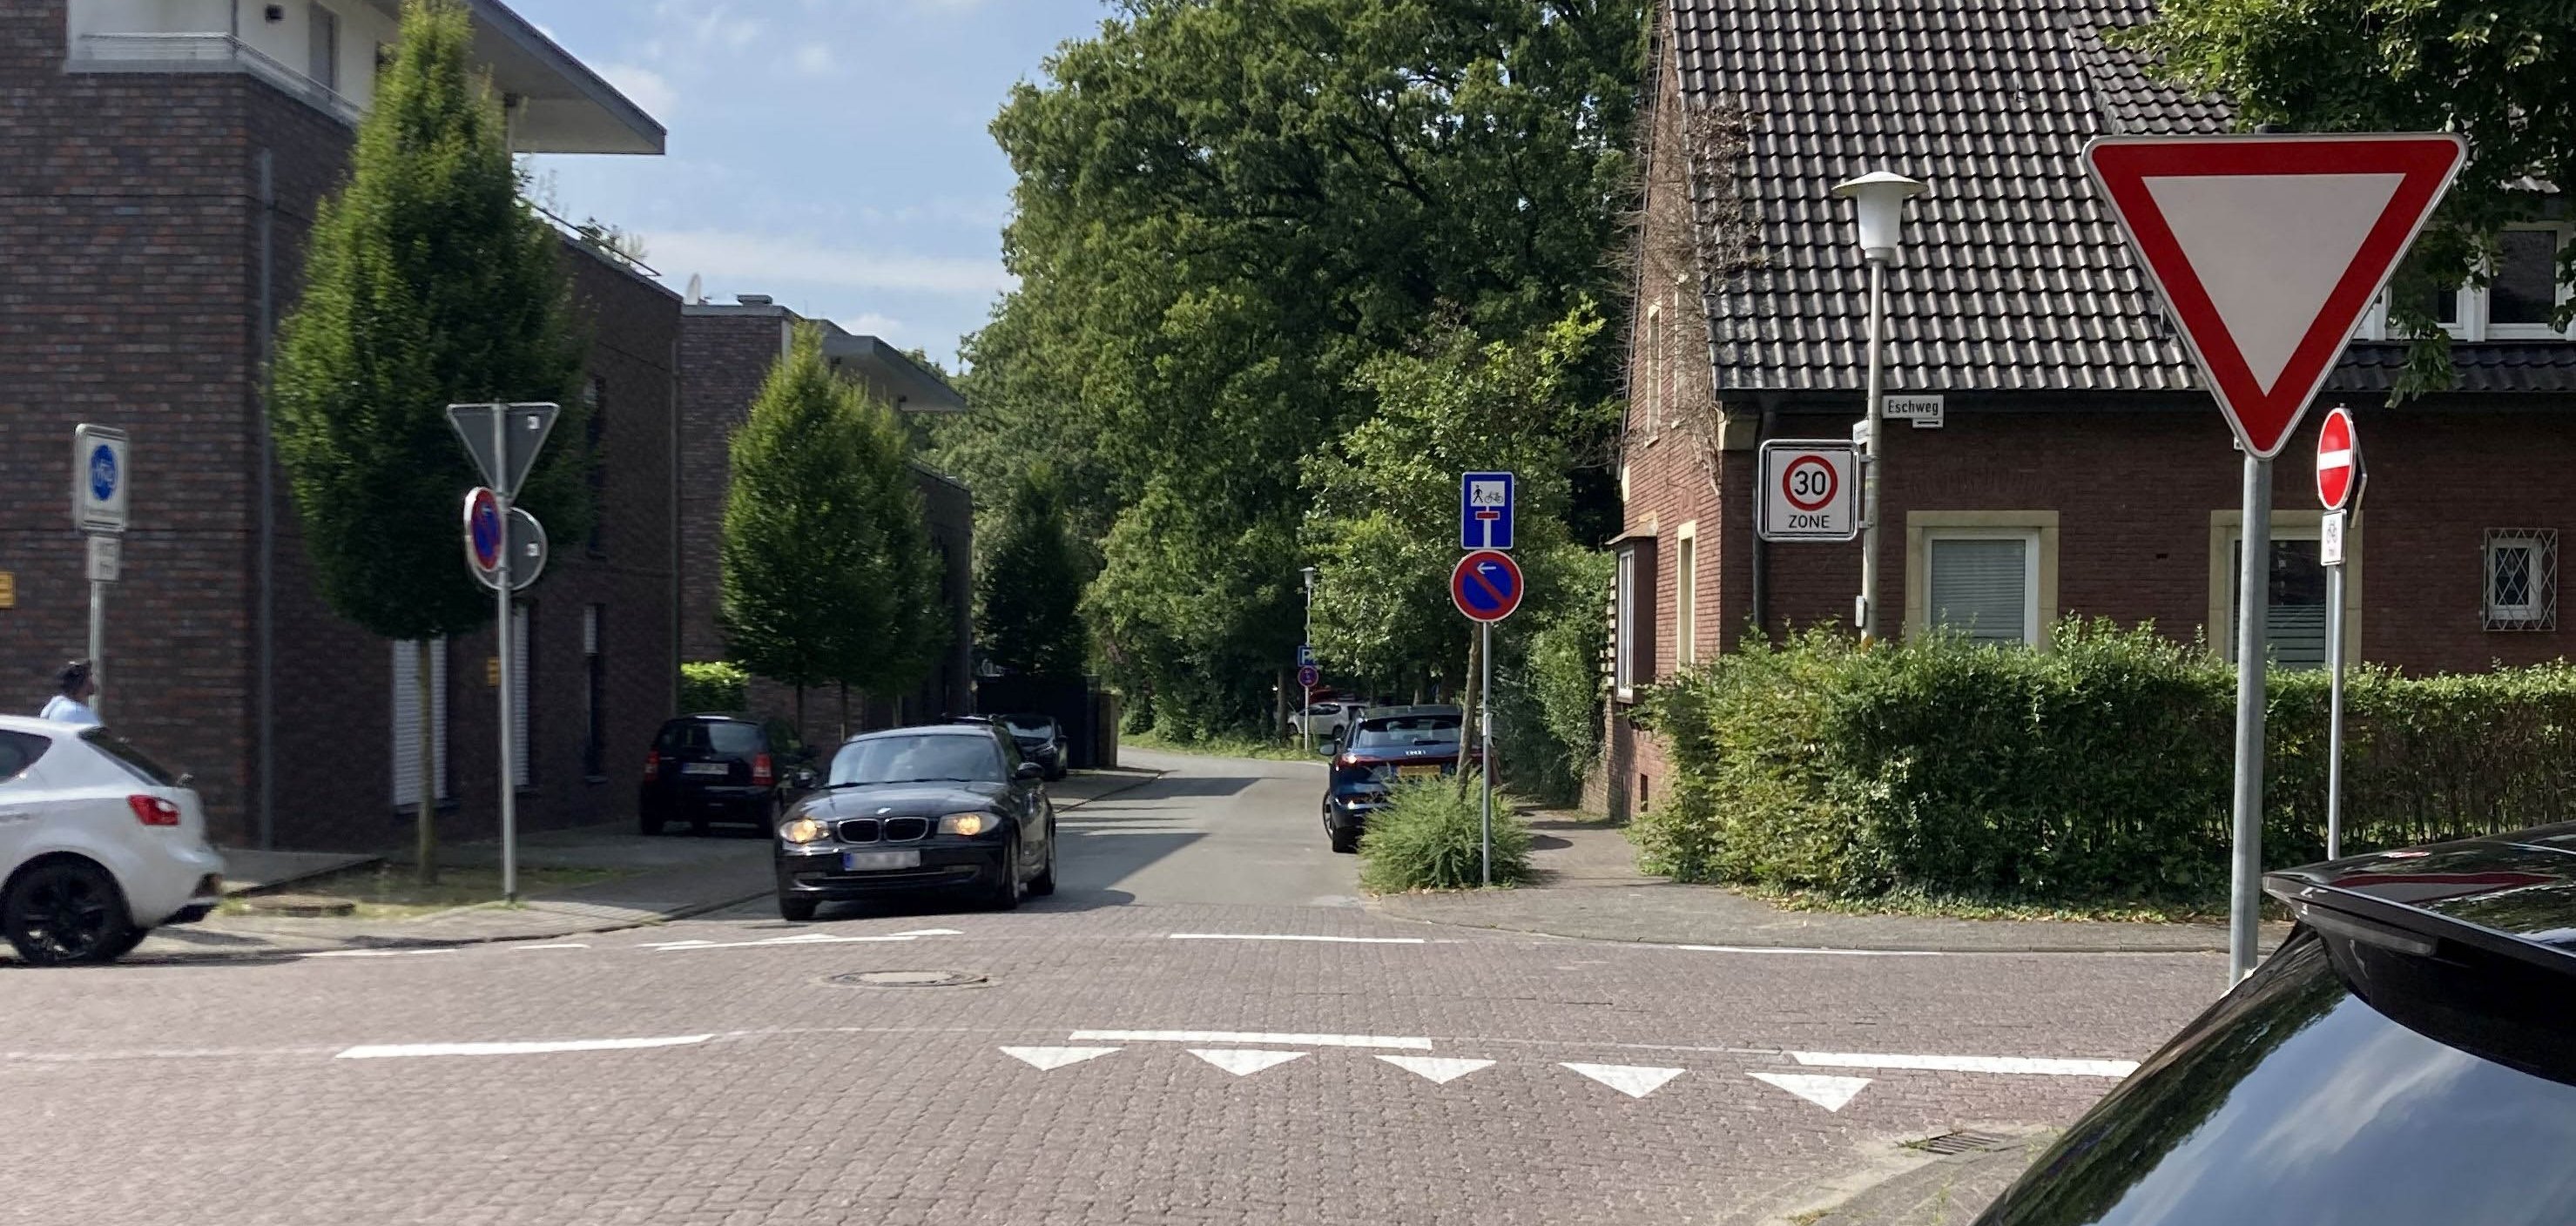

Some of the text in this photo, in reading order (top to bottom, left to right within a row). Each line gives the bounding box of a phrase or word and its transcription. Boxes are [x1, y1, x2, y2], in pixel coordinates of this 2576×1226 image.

[1888, 400, 1939, 415] Eschweg
[1794, 470, 1826, 495] 30
[1788, 515, 1831, 529] ZONE
